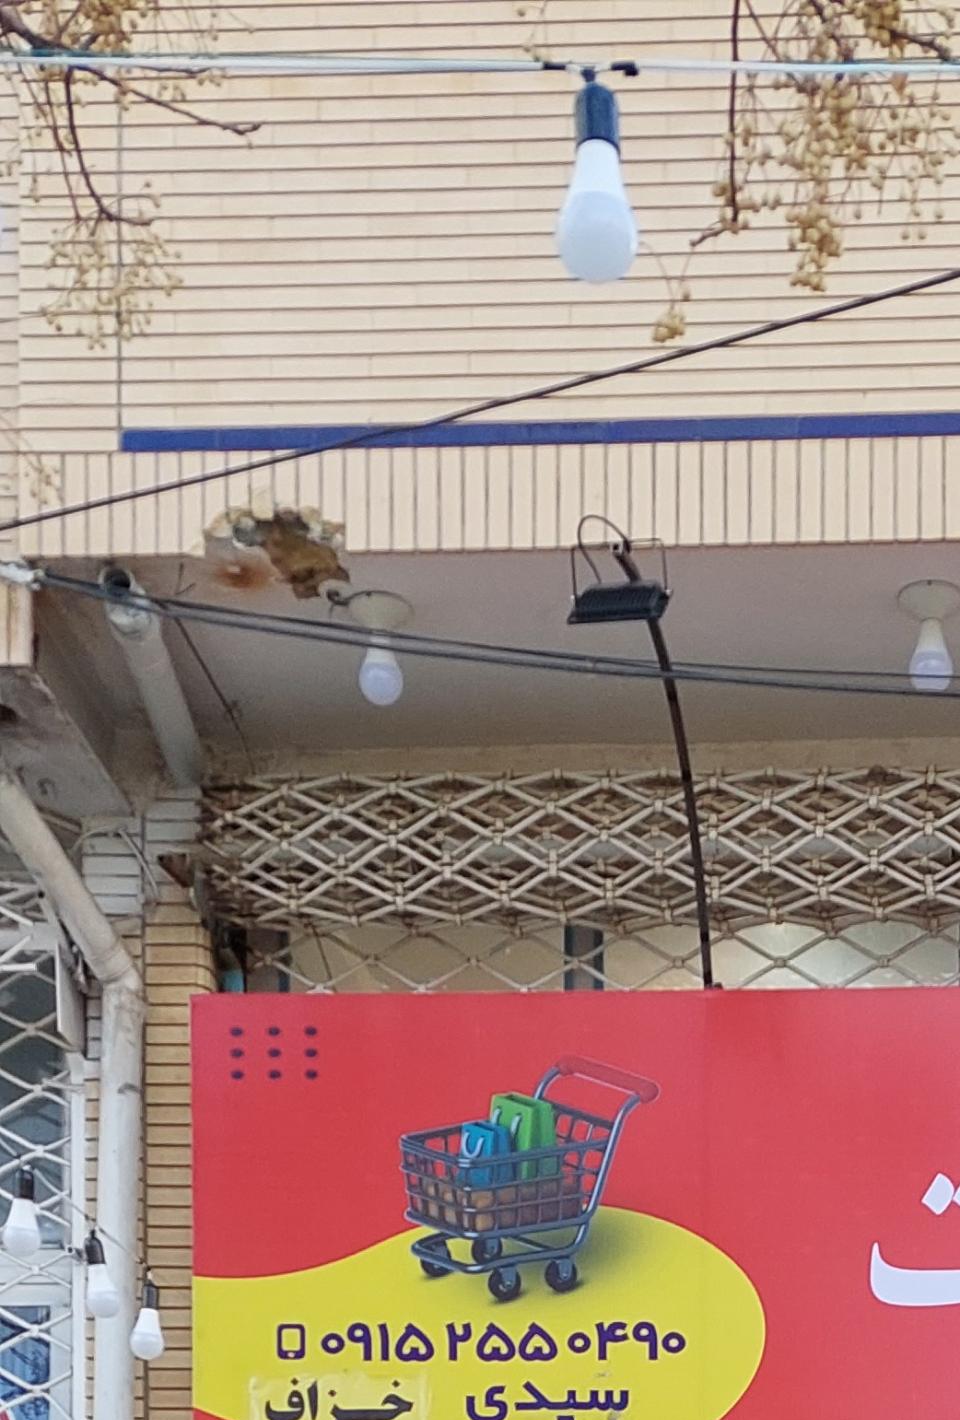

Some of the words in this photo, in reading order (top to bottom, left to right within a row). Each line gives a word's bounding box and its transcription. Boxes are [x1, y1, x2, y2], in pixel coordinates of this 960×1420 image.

[321, 1322, 435, 1362] ۰۹۱۵
[446, 1322, 558, 1362] ۲۵۵
[567, 1321, 686, 1362] ۰۴۹۰
